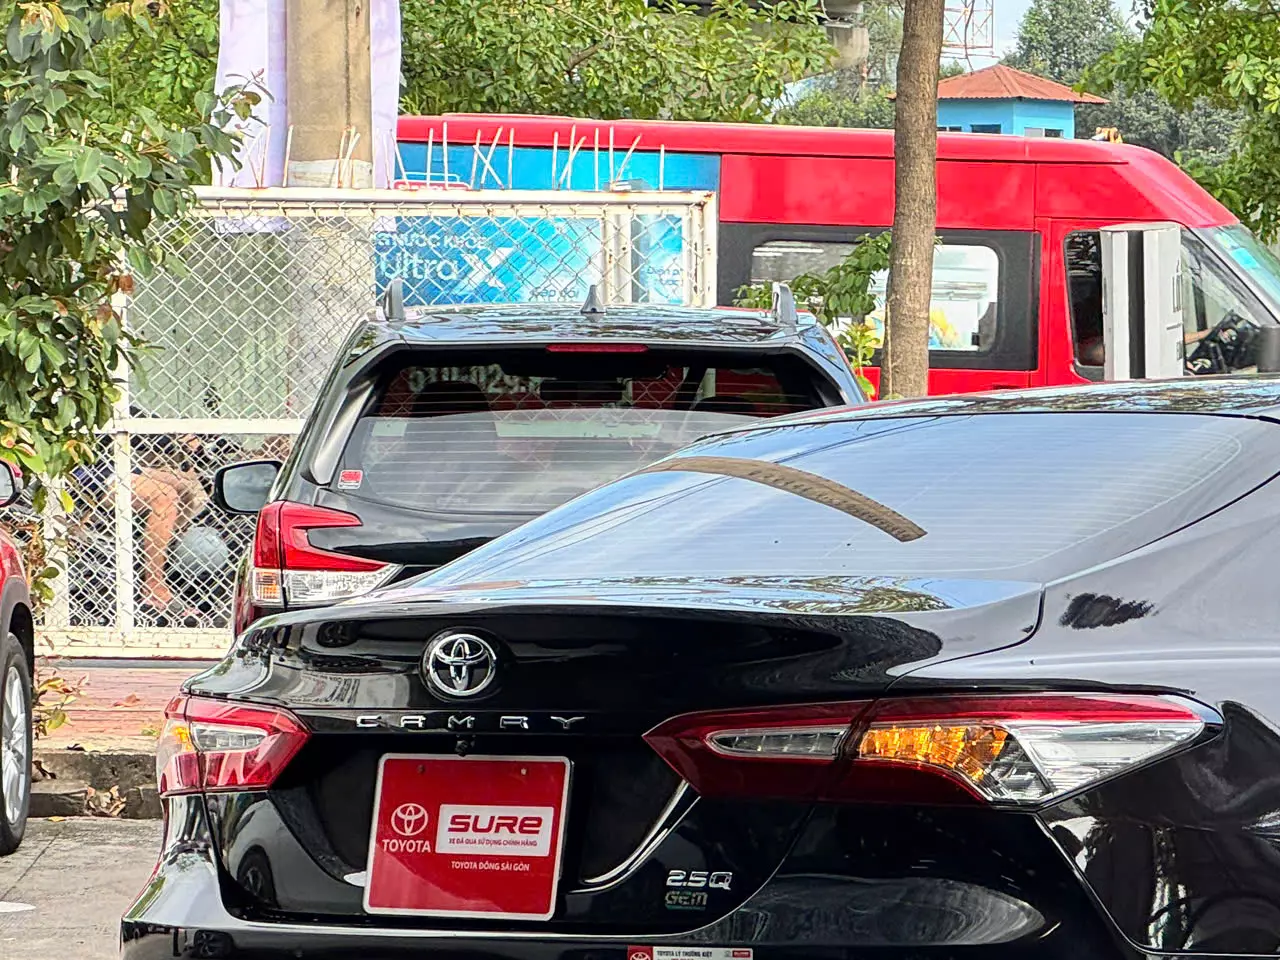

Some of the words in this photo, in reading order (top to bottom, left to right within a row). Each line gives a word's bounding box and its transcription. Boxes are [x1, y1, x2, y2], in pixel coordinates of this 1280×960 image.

[356, 715, 586, 730] CAMRY
[381, 838, 432, 854] TOYOTA
[451, 860, 477, 870] TOYOTA
[478, 860, 500, 871] ĐÔNG
[500, 861, 512, 872] SÀI
[513, 862, 530, 872] GÒN
[665, 869, 733, 891] 2.5Q
